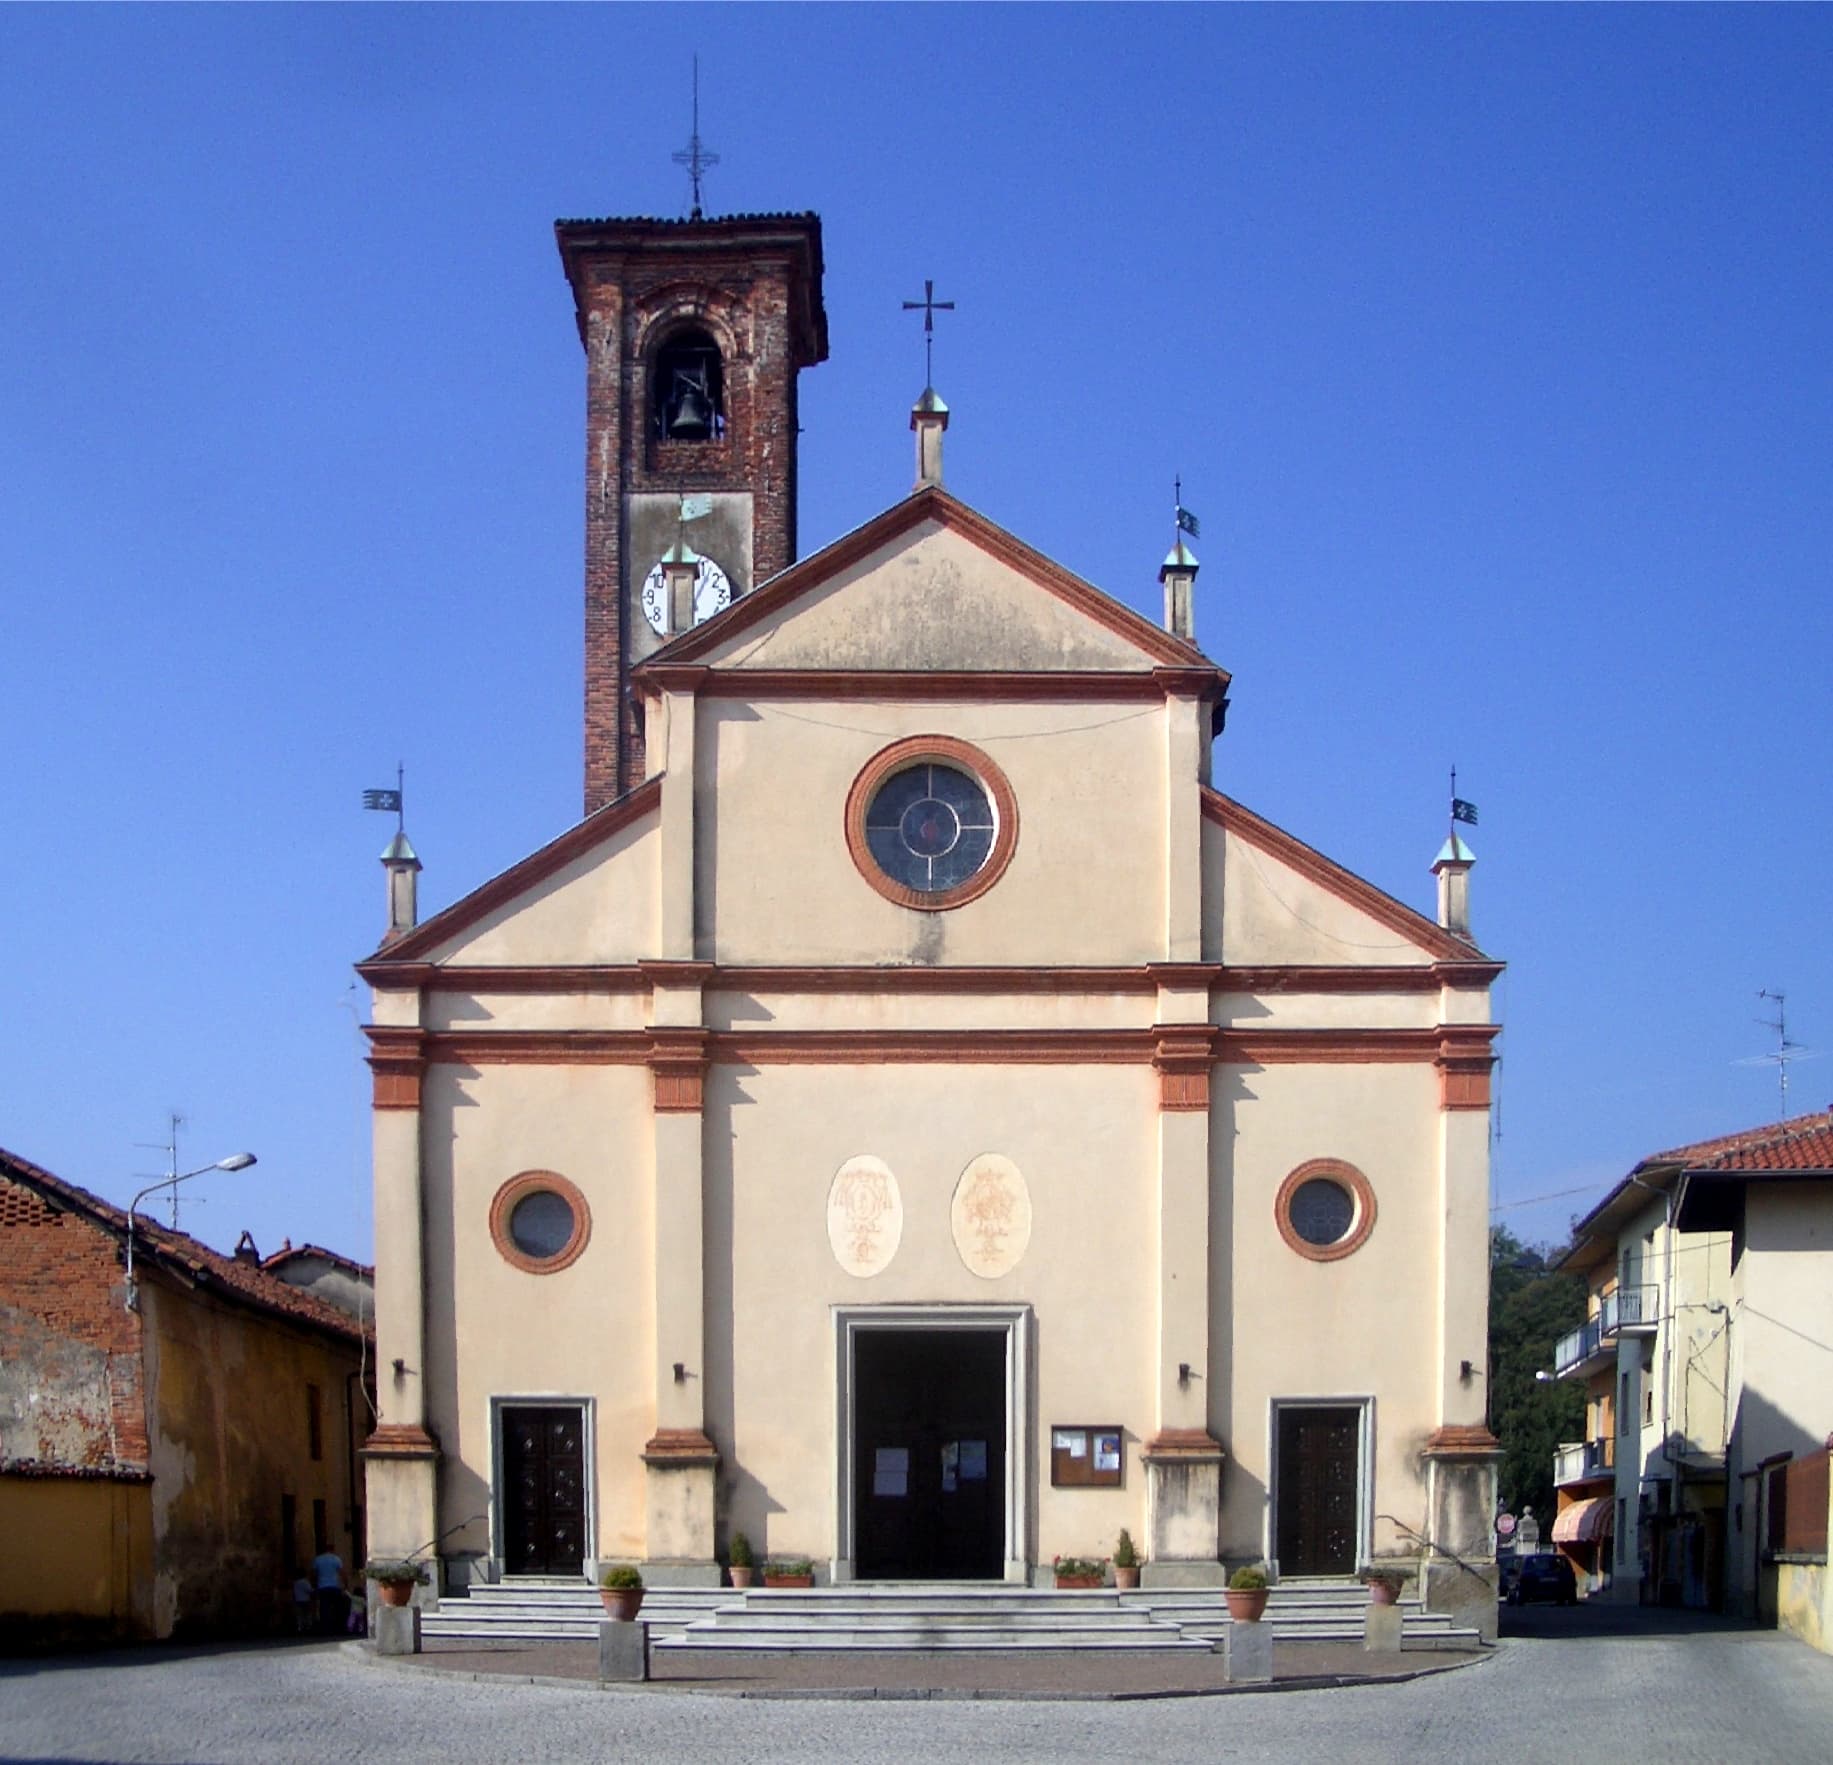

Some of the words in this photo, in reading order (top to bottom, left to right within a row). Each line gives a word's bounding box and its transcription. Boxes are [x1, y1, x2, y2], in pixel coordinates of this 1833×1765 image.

[652, 574, 664, 589] 10
[712, 573, 720, 588] 2
[646, 589, 655, 606] 9
[717, 589, 727, 605] 3
[653, 606, 662, 622] 8
